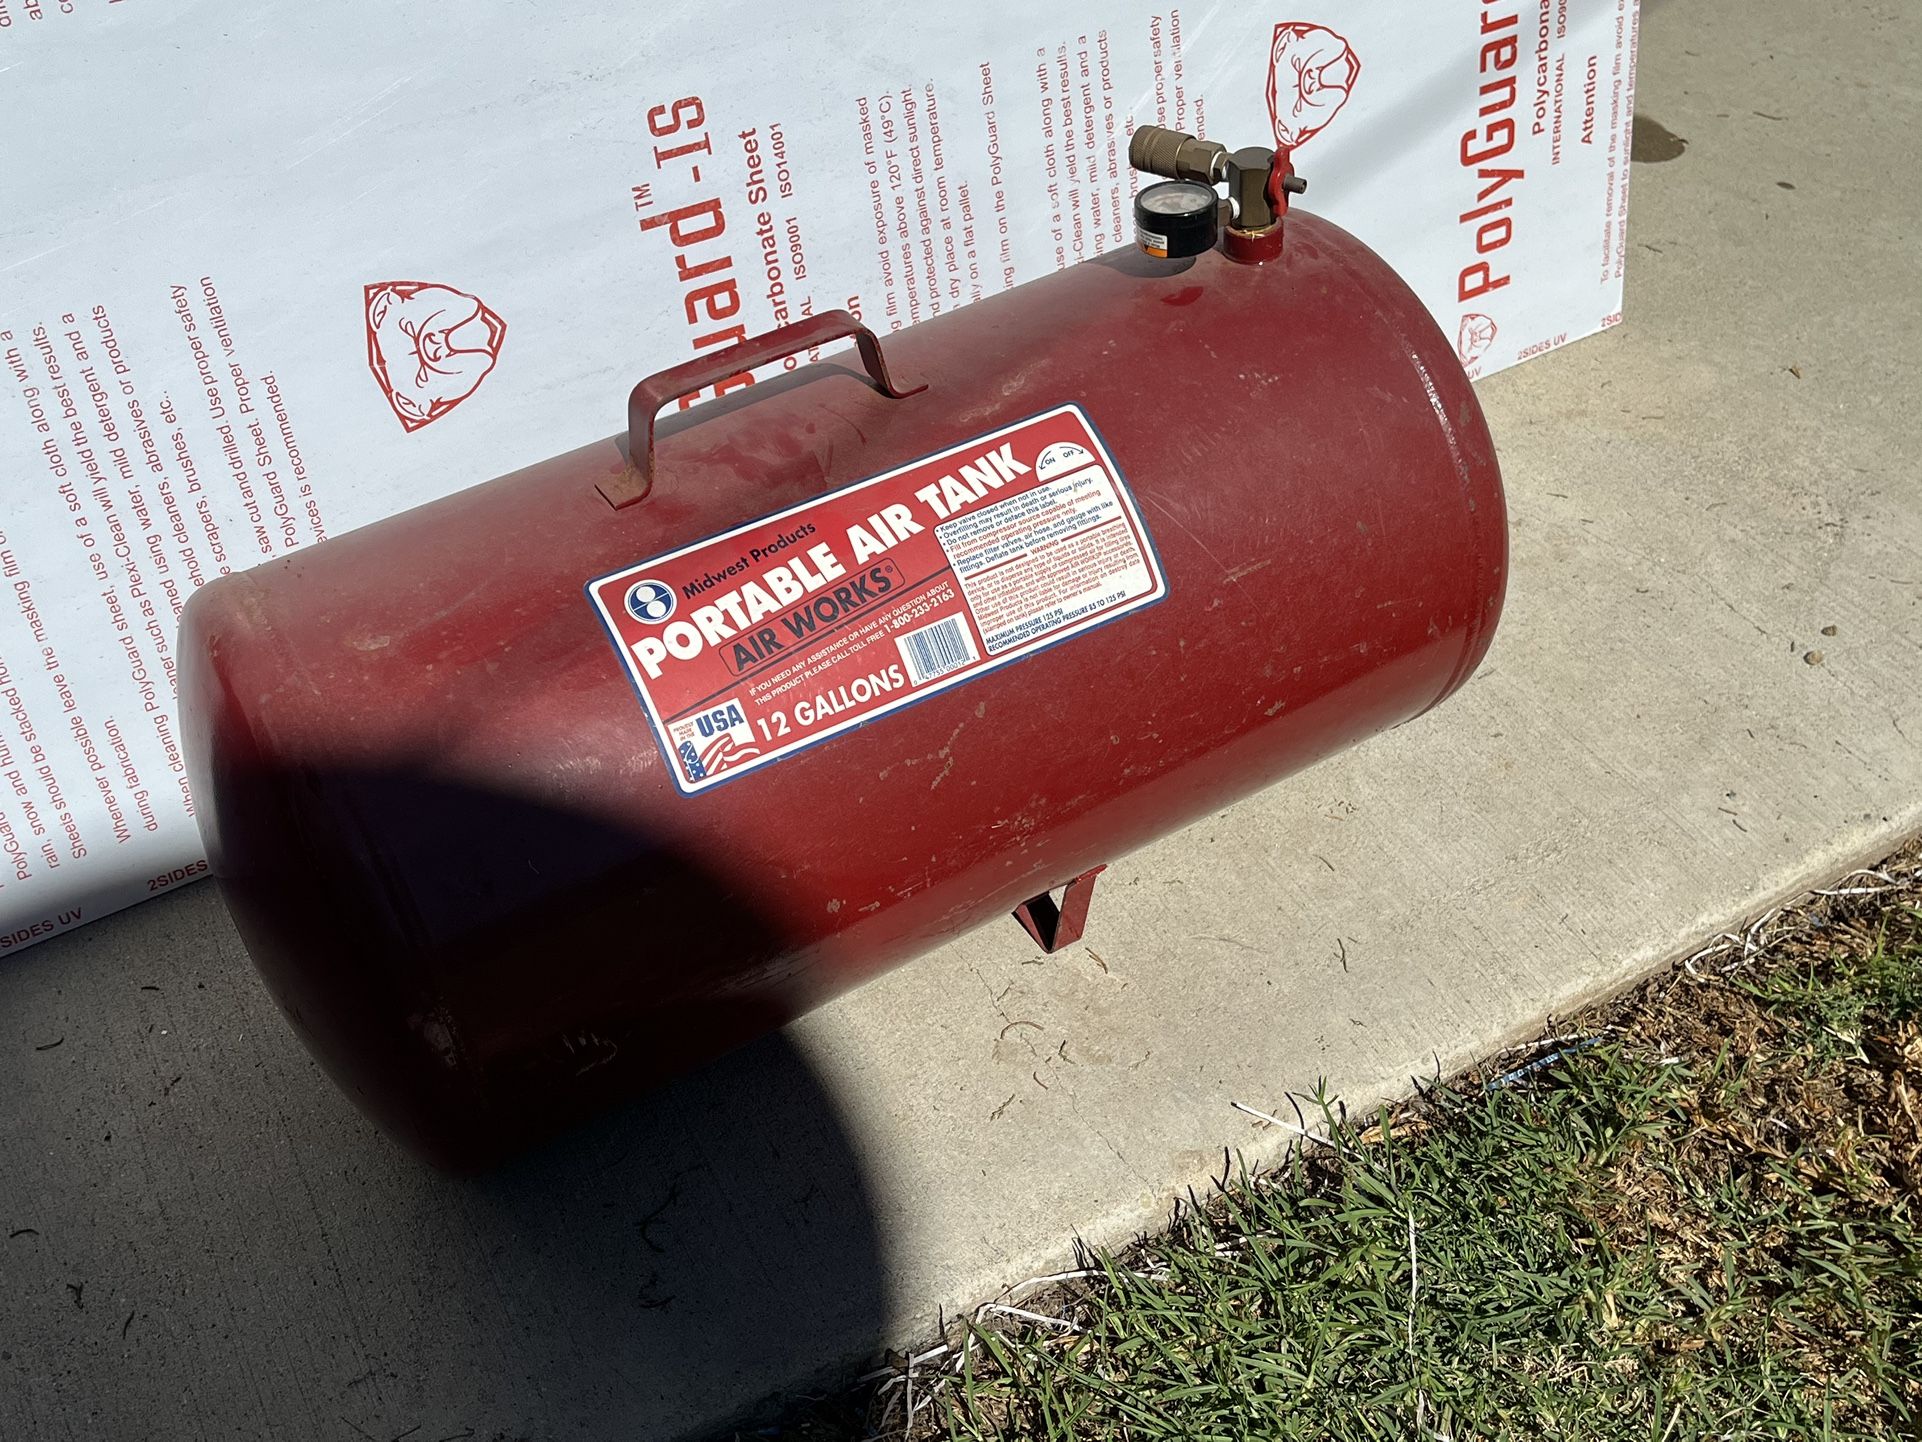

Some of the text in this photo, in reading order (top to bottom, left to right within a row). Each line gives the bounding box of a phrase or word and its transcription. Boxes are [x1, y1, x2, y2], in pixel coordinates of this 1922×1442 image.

[1552, 54, 1564, 165] INTERNATIONAL
[1581, 55, 1597, 144] Attention
[738, 127, 767, 205] Sheet
[908, 145, 924, 184] direct
[1458, 0, 1524, 303] PolyGuar
[1600, 15, 1624, 284] To facilitate removal of the masking film avoid
[769, 123, 807, 280] ISO9001 ISO14001
[855, 97, 898, 316] film avoid exposure of masked
[914, 185, 932, 236] against
[919, 238, 941, 300] protected
[1517, 333, 1566, 360] 2SIDES UV
[92, 305, 189, 544] cleaners, abrasives or products
[200, 276, 299, 548] PolyGuard Sheet. Proper ventilation
[1062, 450, 1074, 458] OFF
[940, 522, 957, 532] Keep
[959, 515, 976, 525] valve
[977, 506, 998, 518] closed
[1000, 499, 1017, 509] when
[943, 522, 979, 539] Overfilling
[993, 508, 1013, 519] result
[1020, 498, 1040, 509] death
[1048, 485, 1073, 498] serious
[1072, 478, 1092, 491] injury.
[949, 543, 962, 552] Fill
[961, 538, 978, 548] from
[978, 522, 1017, 542] compressor
[1018, 513, 1041, 526] source
[1041, 503, 1066, 517] capable
[1075, 490, 1101, 503] meeting
[953, 508, 1076, 560] recommended operating pressure only.
[956, 552, 984, 566] Replace
[984, 545, 999, 555] filter
[1001, 537, 1022, 549] valves,
[1033, 526, 1053, 536] hose,
[1066, 512, 1086, 524] gauge
[1086, 505, 1101, 515] with
[1100, 501, 1113, 509] like
[970, 524, 995, 536] remove
[1004, 511, 1026, 524] deface
[1026, 506, 1039, 515] this
[1039, 499, 1057, 509] label.
[630, 442, 1032, 680] PORTABLE AIR TANK
[682, 523, 816, 600] Midwest Products
[959, 514, 1102, 573] fittings. Deflate tank before removing fittings.
[1030, 539, 1059, 555] WARNING
[732, 626, 784, 672] AIR
[749, 581, 948, 696] IF YOU NEED ANY ASSISTANCE OR HAVE ANY QUESTION ABOUT
[754, 589, 954, 705] THIS PRODUCT PLEASE CALL TOLL FREE 1-800-233-2163
[986, 608, 1063, 645] MAXIMUM PRESSURE 125 PSI
[988, 590, 1126, 652] RECOMMENDED OPERATING PRESSURE 85 TO 125 PSI
[0, 549, 132, 845] Whenever possible leave the masking film
[695, 704, 744, 738] USA
[756, 663, 904, 742] 12 GALLONS
[2, 687, 87, 861] Sheets should be stacked
[104, 716, 158, 832] during fabrication.
[147, 860, 208, 891] 2SIDES
